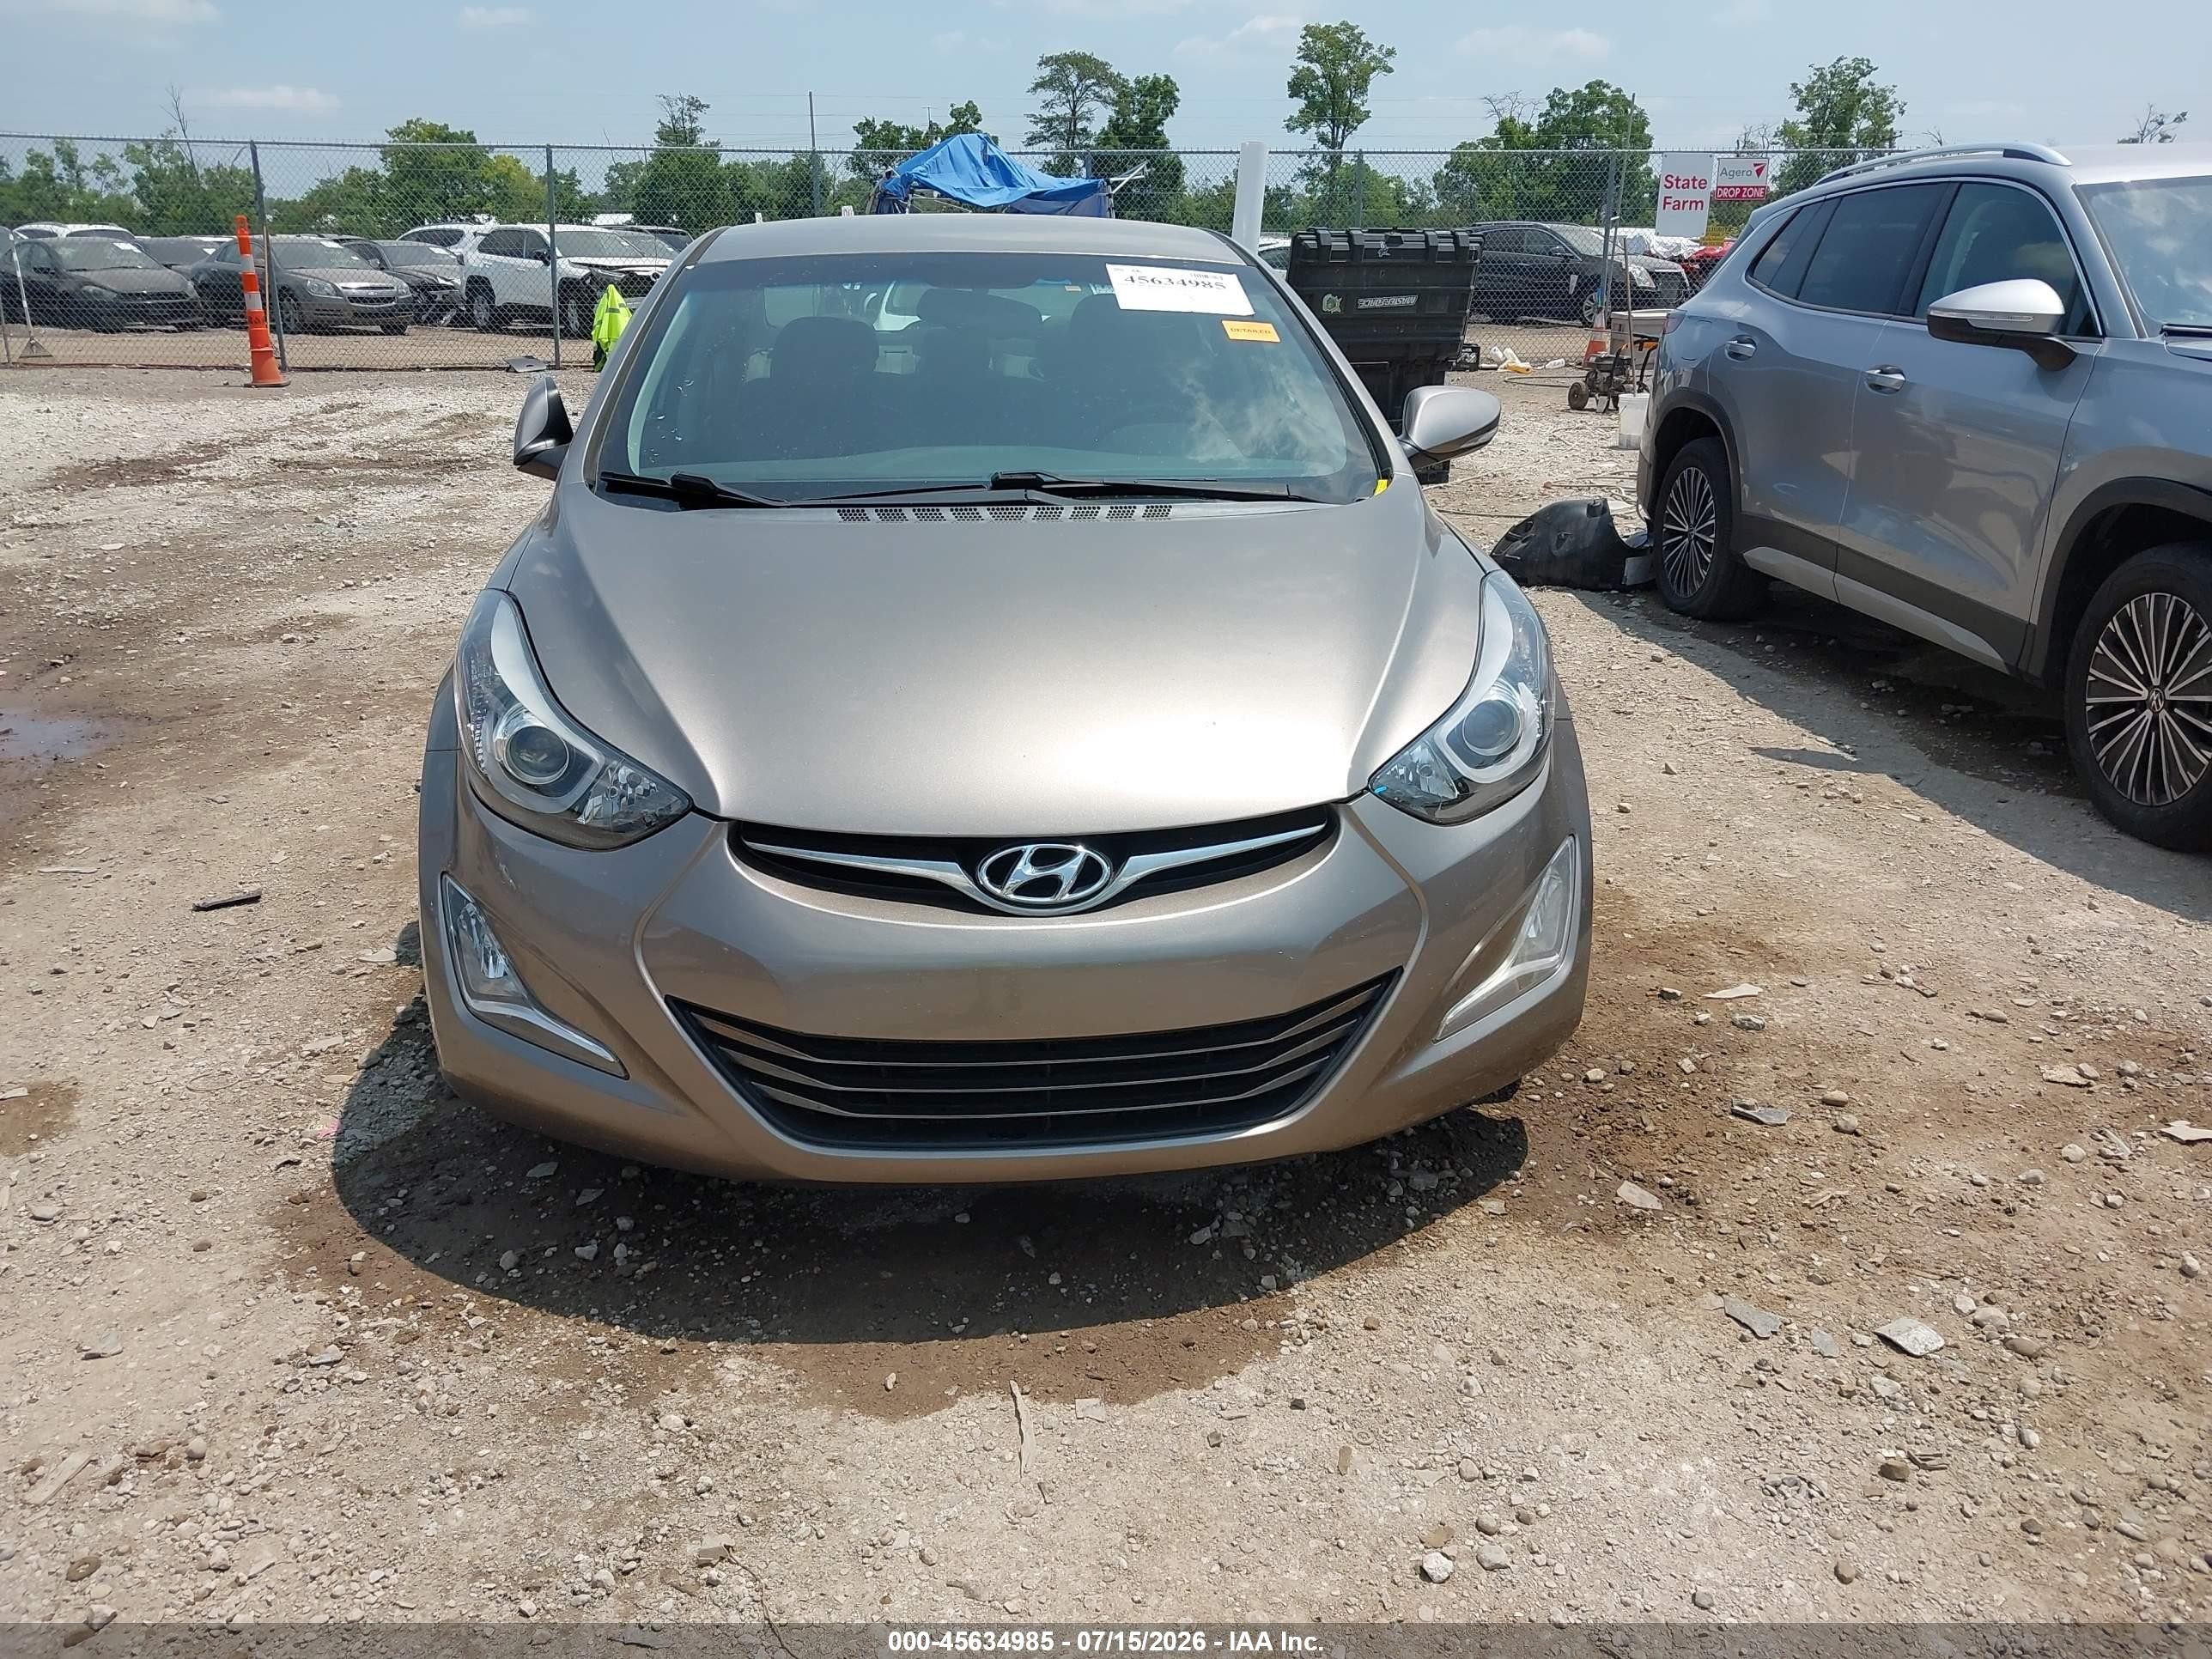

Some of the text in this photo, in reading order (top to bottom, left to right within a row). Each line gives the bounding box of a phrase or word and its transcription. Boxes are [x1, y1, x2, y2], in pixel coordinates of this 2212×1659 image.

[1720, 167, 1753, 179] Agero
[1663, 174, 1708, 190] State
[1717, 188, 1765, 198] DROP ZONE
[1662, 197, 1705, 210] Farm
[1124, 275, 1227, 290] 45634985
